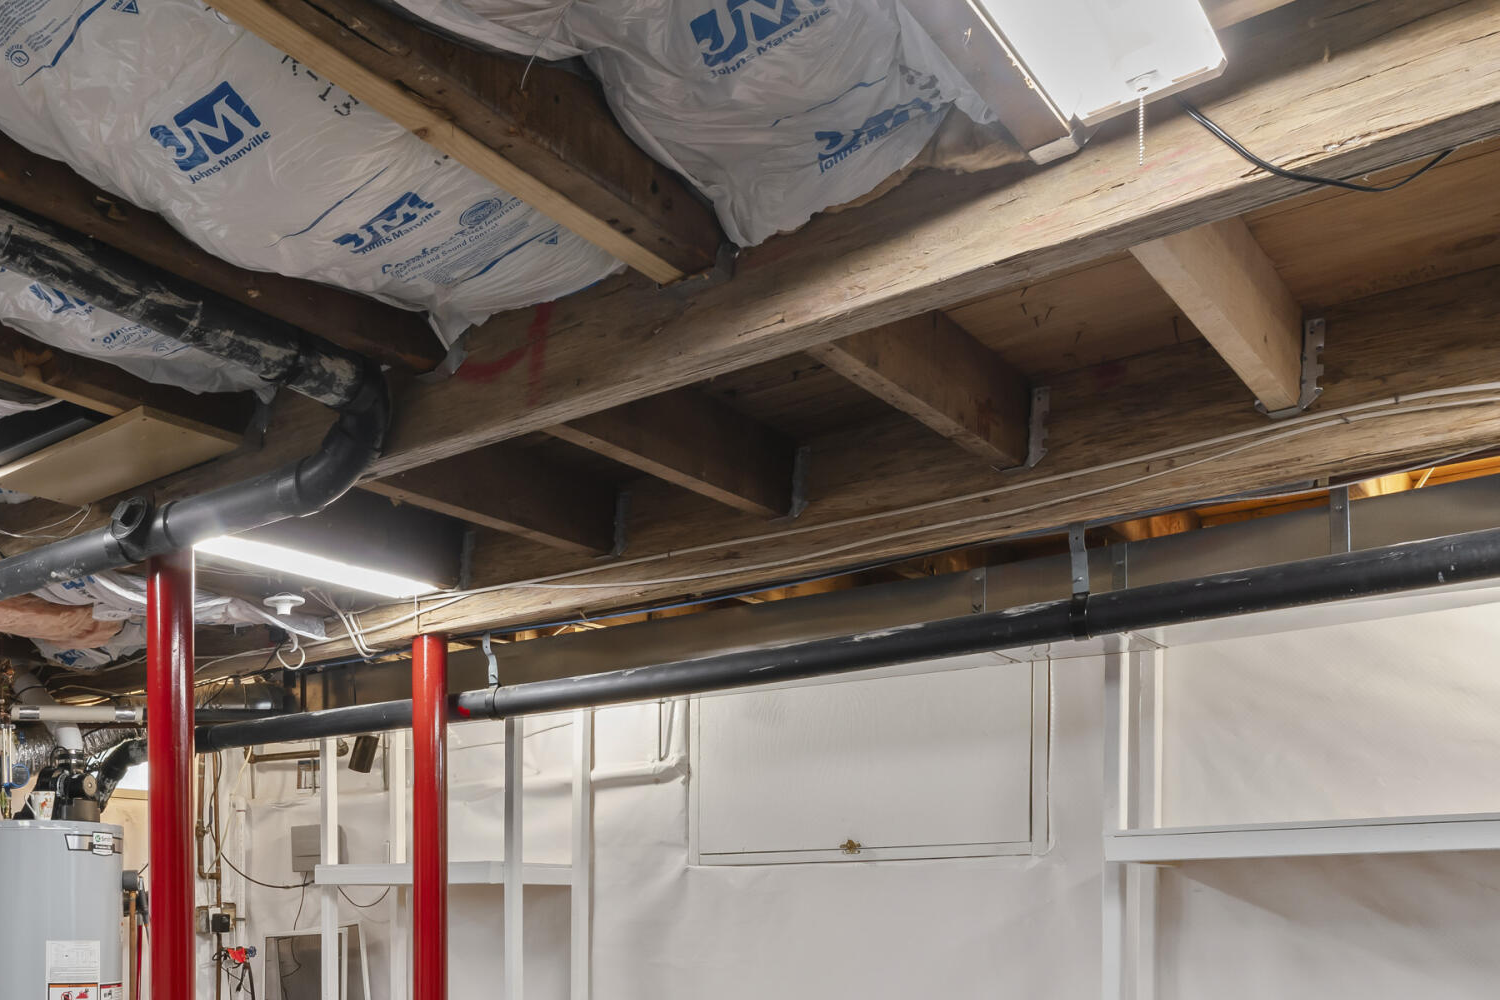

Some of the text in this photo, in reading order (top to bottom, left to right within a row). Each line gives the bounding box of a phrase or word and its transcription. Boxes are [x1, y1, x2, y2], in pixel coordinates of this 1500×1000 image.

[710, 6, 831, 79] Johns Manville
[150, 80, 261, 172] JM
[189, 129, 272, 185] Johns Manville
